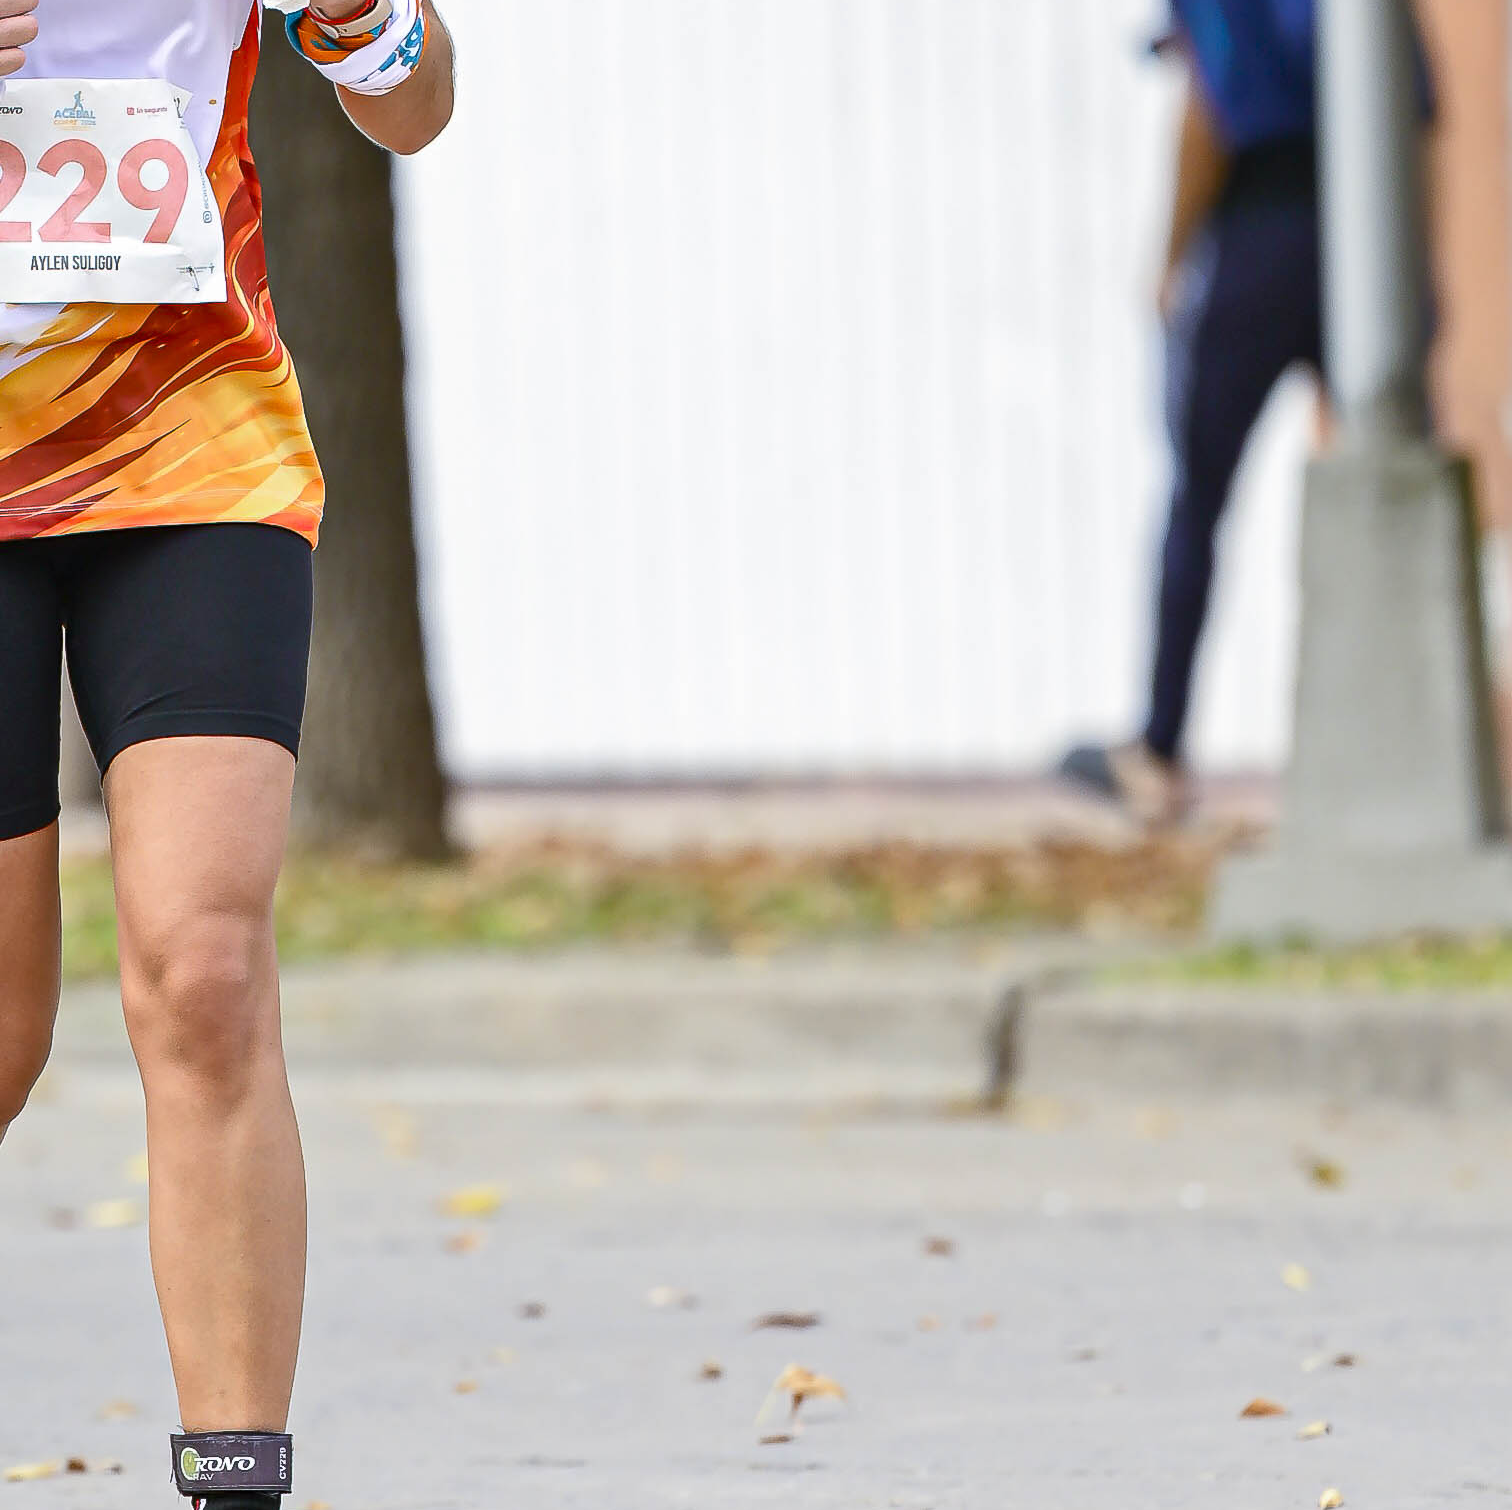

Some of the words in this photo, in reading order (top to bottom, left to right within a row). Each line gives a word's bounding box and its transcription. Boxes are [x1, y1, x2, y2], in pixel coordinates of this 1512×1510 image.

[54, 109, 97, 119] ACEBAL
[31, 255, 69, 271] AYLEN
[72, 255, 121, 271] SULIGOY
